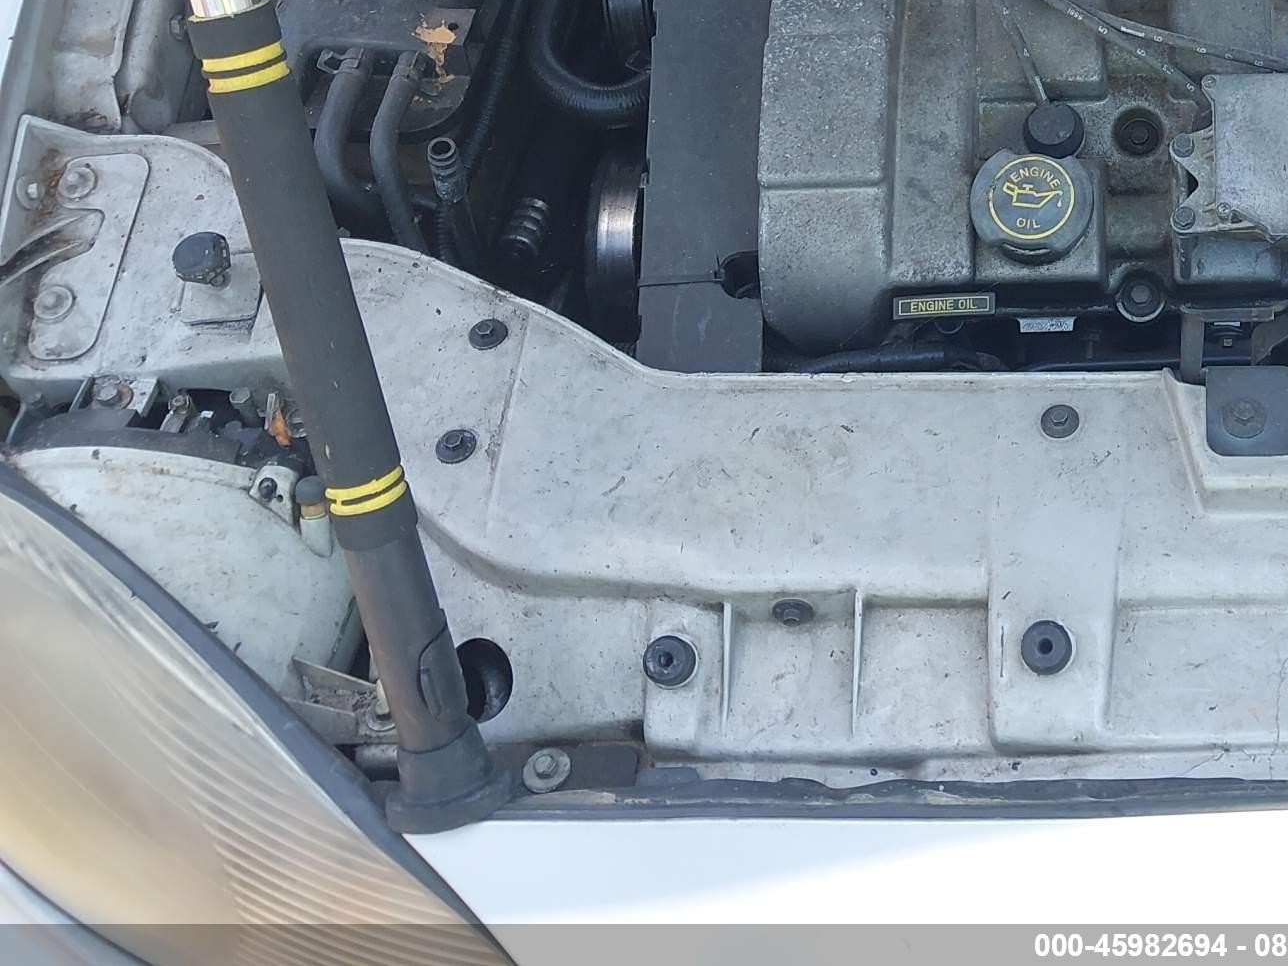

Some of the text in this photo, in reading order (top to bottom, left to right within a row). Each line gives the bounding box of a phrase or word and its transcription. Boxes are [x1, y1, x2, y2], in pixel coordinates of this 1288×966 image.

[1010, 166, 1061, 189] ENGINE
[1016, 217, 1041, 229] OIL
[910, 299, 978, 312] ENGINE OIL
